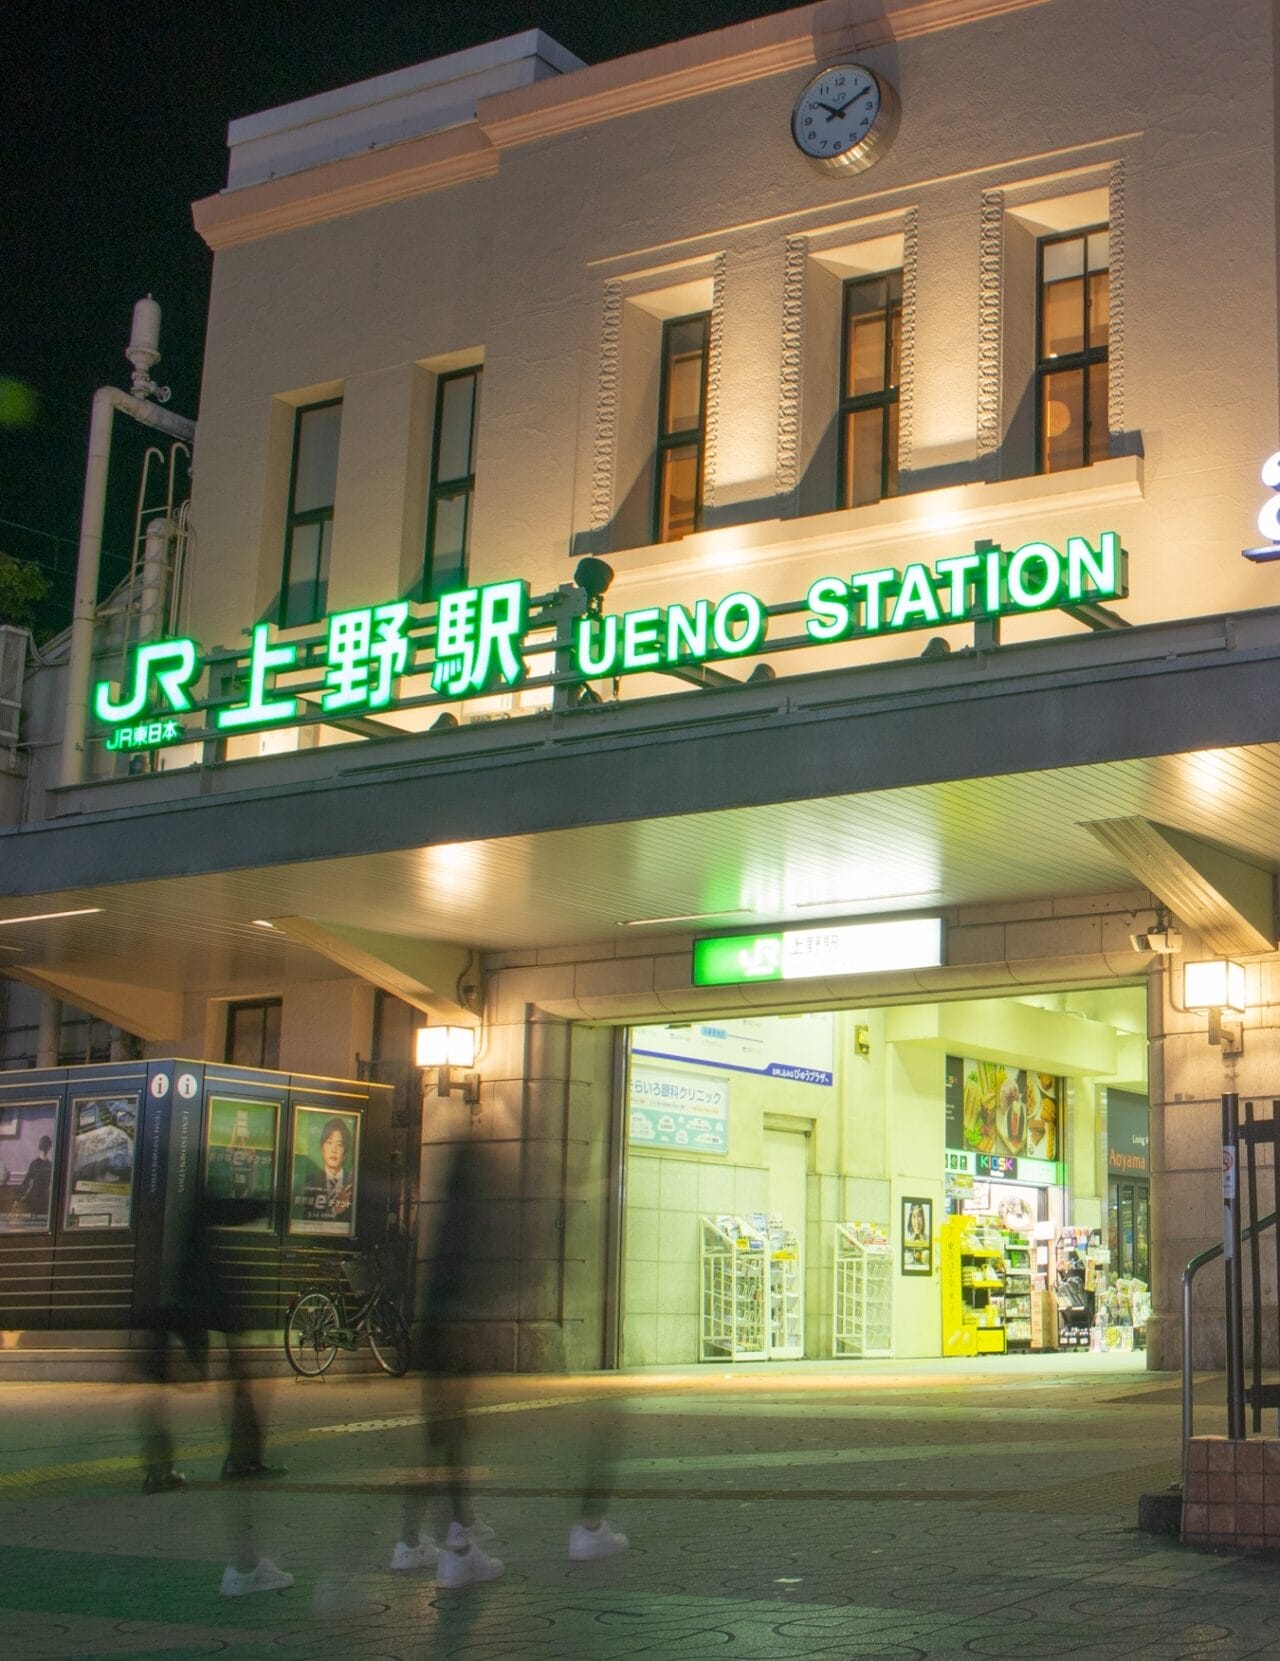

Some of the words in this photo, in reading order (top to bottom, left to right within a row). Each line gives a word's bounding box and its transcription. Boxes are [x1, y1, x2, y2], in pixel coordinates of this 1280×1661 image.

[835, 77, 846, 87] 12
[820, 86, 830, 96] 11
[865, 101, 873, 111] 3
[805, 118, 813, 126] 9
[860, 118, 869, 126] 4
[820, 140, 829, 150] 7
[833, 141, 842, 150] 6
[95, 638, 199, 724] JR
[216, 579, 526, 730] 上野駅
[576, 591, 766, 676] UENO
[805, 532, 1122, 643] STATION
[104, 720, 178, 750] JR東日本
[739, 938, 781, 968] JR
[790, 933, 839, 956] 上野駅
[979, 1154, 1014, 1172] KIOSK
[1110, 1147, 1146, 1172] Aoyama
